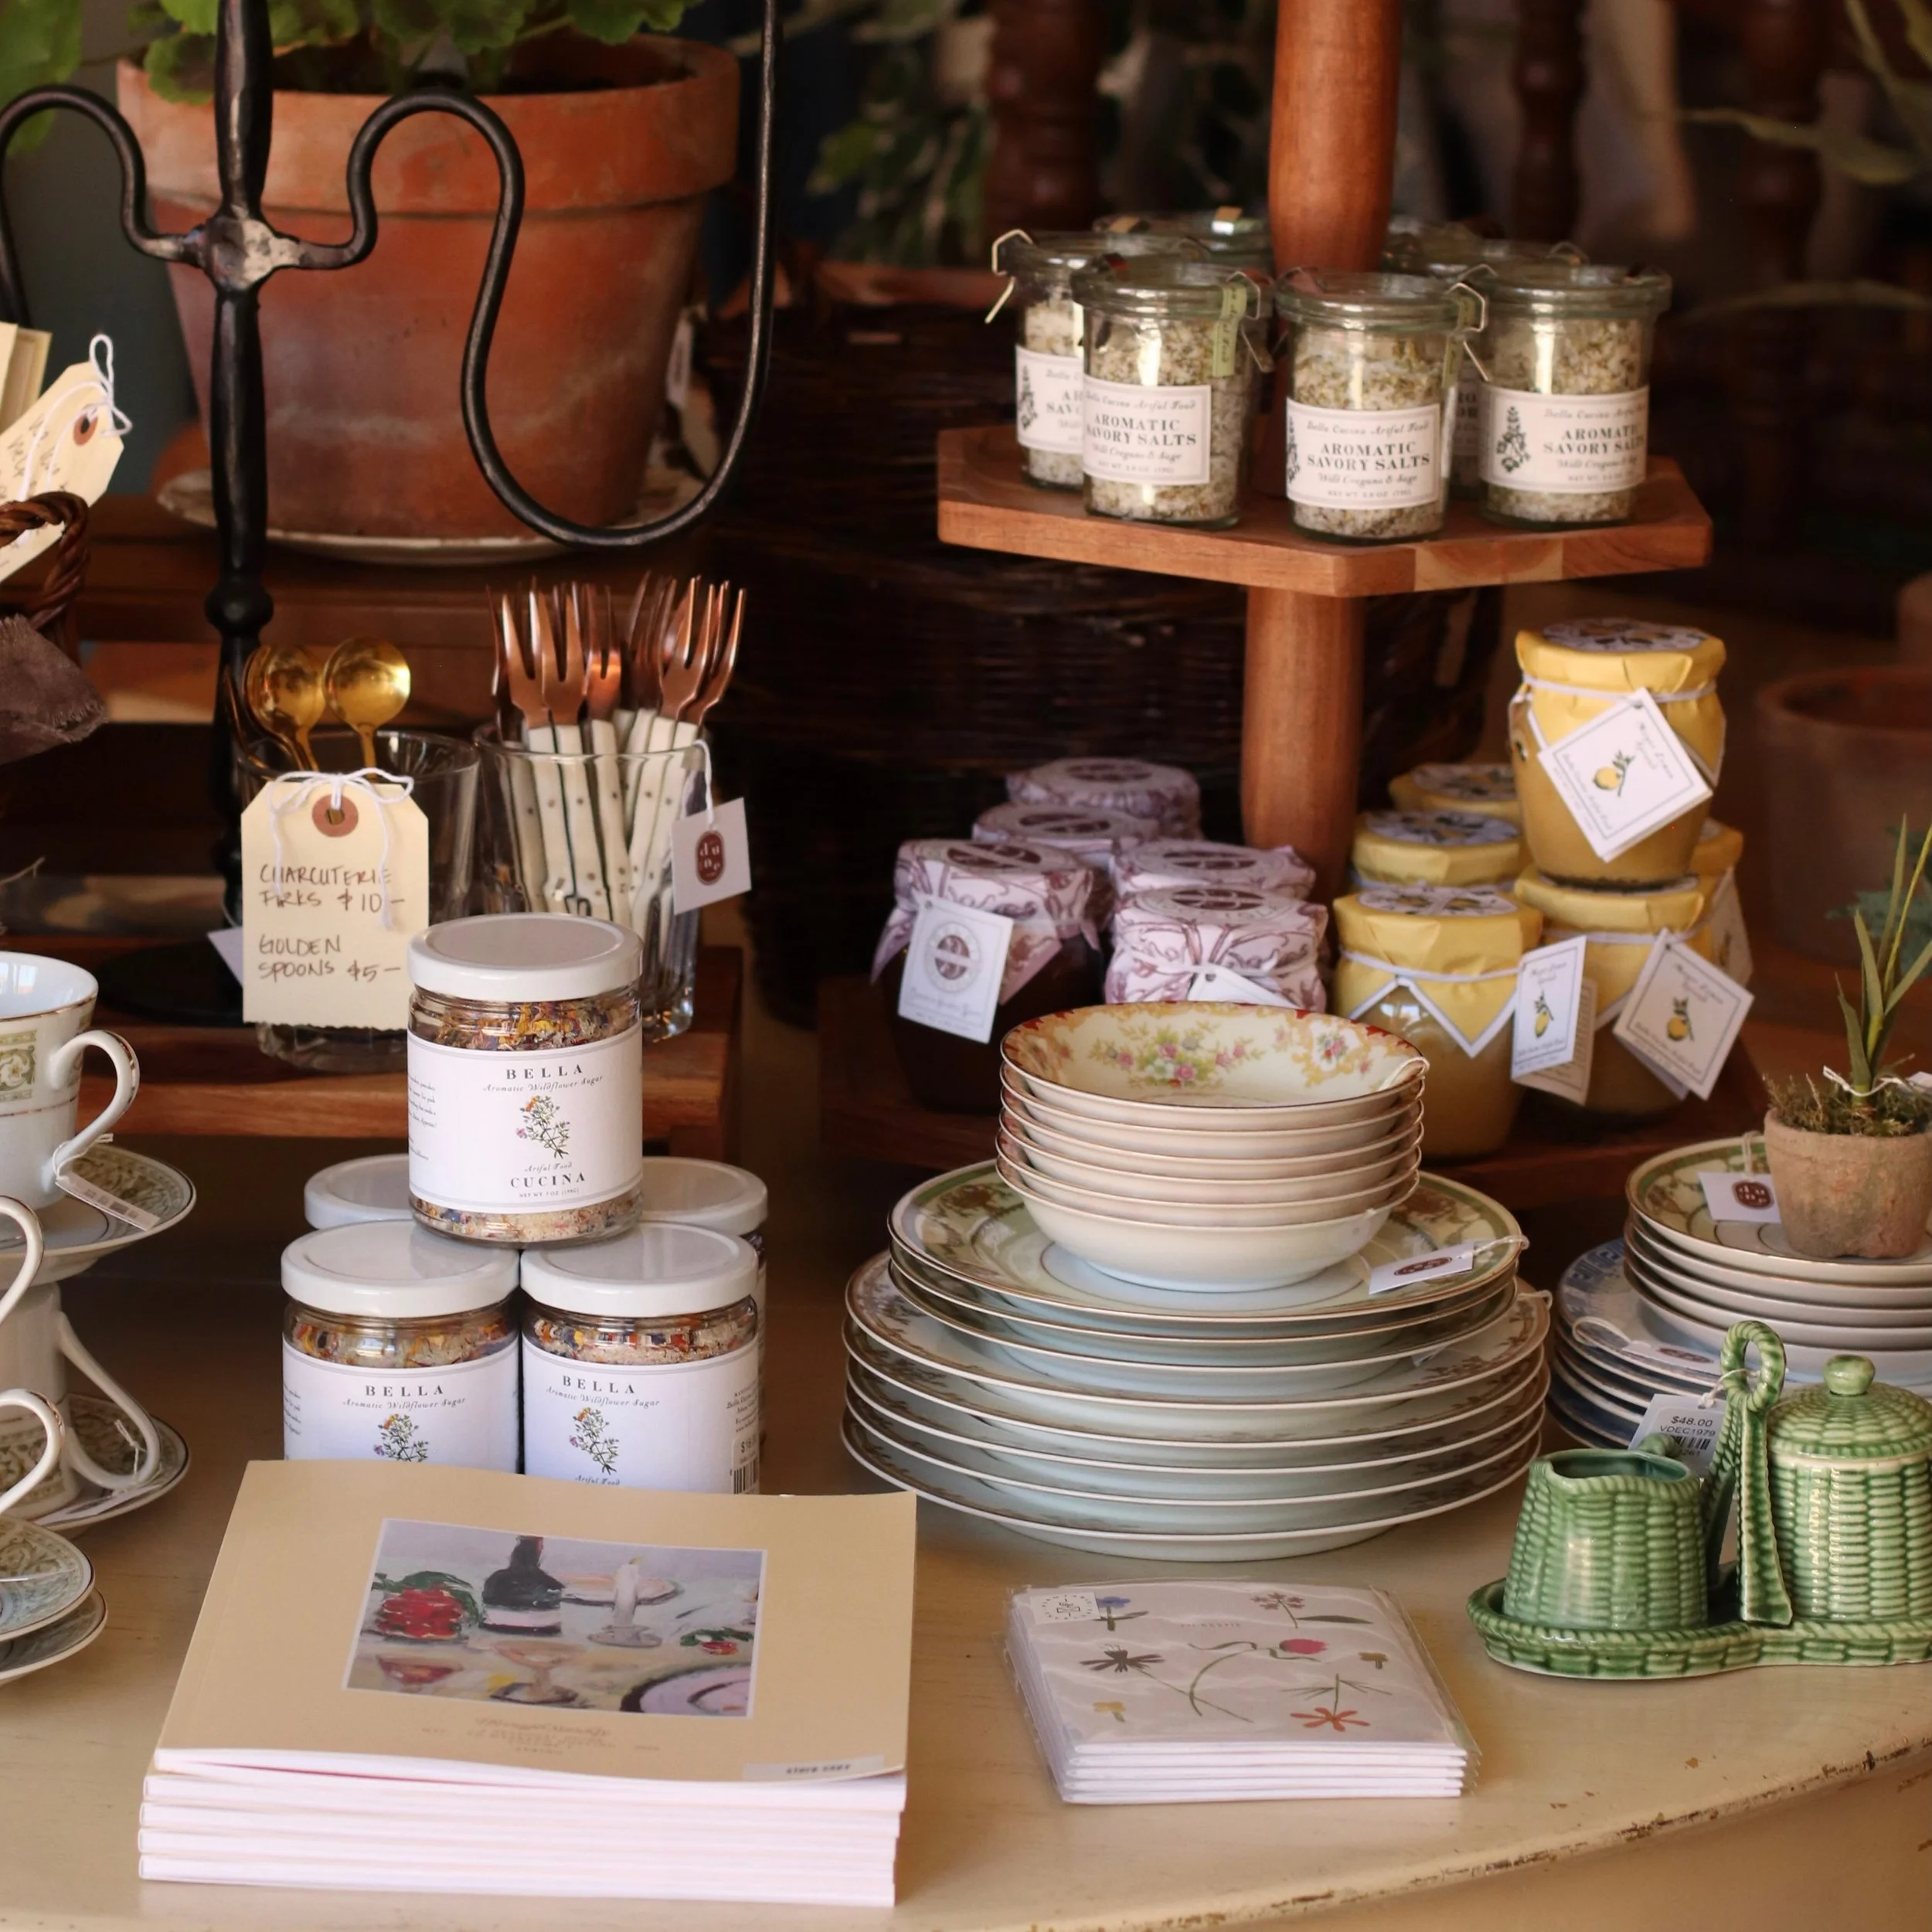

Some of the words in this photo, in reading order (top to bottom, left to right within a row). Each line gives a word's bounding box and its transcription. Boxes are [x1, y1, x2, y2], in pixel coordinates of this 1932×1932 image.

[1094, 413, 1180, 431] AROMATIC
[1085, 423, 1131, 445] SAVORY
[1138, 433, 1196, 446] SALTS
[1321, 440, 1417, 457] AROMATIC
[1544, 441, 1609, 455] SAVORY
[1308, 454, 1368, 471] SAVORY
[1375, 453, 1430, 471] SALTS
[259, 934, 342, 957] GOLDEN
[258, 959, 335, 983] SPOONS
[505, 1063, 583, 1080] BELLA
[482, 1083, 525, 1093] Aromatic
[528, 1080, 578, 1093] Wildflower
[580, 1076, 604, 1087] Sugar
[525, 1164, 551, 1174] Artful
[553, 1161, 573, 1170] Food
[510, 1172, 586, 1188] CUCINA
[365, 1384, 444, 1397] BELLA
[562, 1374, 635, 1394] BELLA
[341, 1399, 383, 1410] Aromatic
[386, 1400, 439, 1411] Wildflower
[441, 1397, 467, 1408] Sugar
[545, 1386, 577, 1401] Aromatic
[580, 1393, 630, 1407] Wildflower
[632, 1399, 661, 1410] Sugar
[1671, 1415, 1714, 1427] $48.00
[1660, 1424, 1716, 1437] VDEC1979
[575, 1475, 598, 1485] Artful
[600, 1477, 621, 1486] Food
